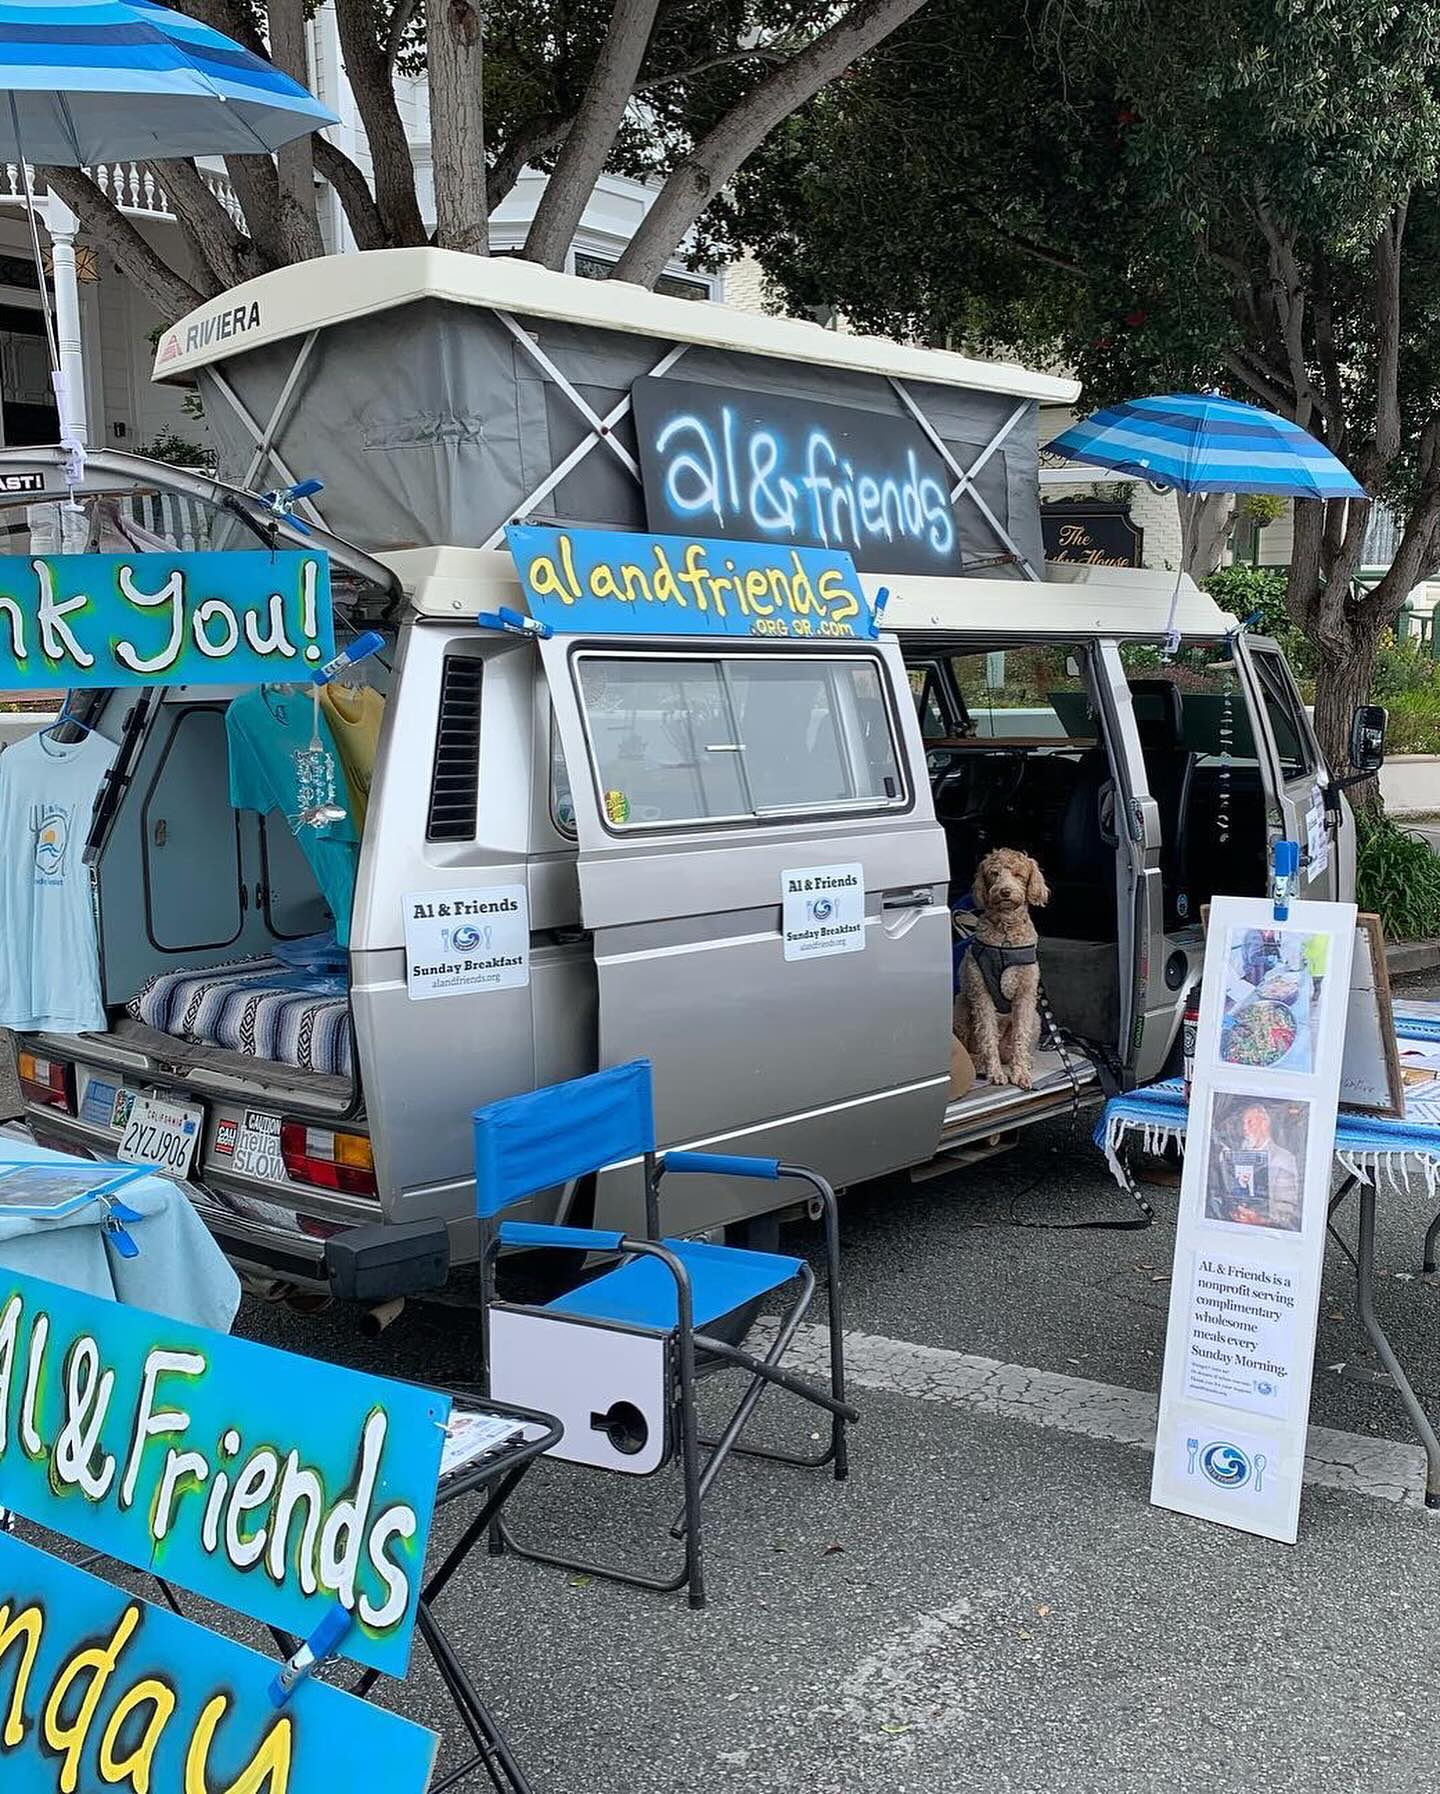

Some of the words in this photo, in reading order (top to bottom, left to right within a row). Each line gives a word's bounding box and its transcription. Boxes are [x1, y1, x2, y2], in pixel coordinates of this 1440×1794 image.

[186, 301, 260, 352] RIVIERA
[1059, 525, 1094, 546] The
[117, 560, 321, 673] You!
[751, 618, 788, 636] .ORG
[792, 619, 813, 636] OR
[804, 879, 813, 891] &
[814, 874, 858, 890] Friends
[413, 903, 435, 919] Al
[438, 902, 452, 917] &
[453, 898, 519, 916] Friends
[786, 929, 819, 942] Sunday
[820, 922, 861, 938] Breakfast
[413, 962, 462, 977] Sunday
[464, 955, 523, 972] Breakfast
[432, 973, 501, 989] alandfriends.org
[218, 1126, 237, 1140] CALI
[248, 1113, 281, 1135] CAUTION
[123, 1121, 191, 1168] 2YZJ906
[234, 1149, 286, 1182] SLOW
[1199, 1261, 1215, 1273] AL
[1216, 1263, 1225, 1275] &
[1227, 1265, 1271, 1283] Friends
[1273, 1273, 1282, 1285] is
[1284, 1278, 1291, 1287] a
[1198, 1279, 1250, 1297] nonprofit
[1252, 1290, 1294, 1308] serving
[1196, 1296, 1282, 1322] complimentary
[1195, 1311, 1258, 1333] wholesome
[1193, 1329, 1226, 1344] meals
[1227, 1336, 1258, 1353] every
[1191, 1345, 1233, 1366] Sunday
[1234, 1354, 1288, 1378] Morning.
[121, 1350, 416, 1628] Friends
